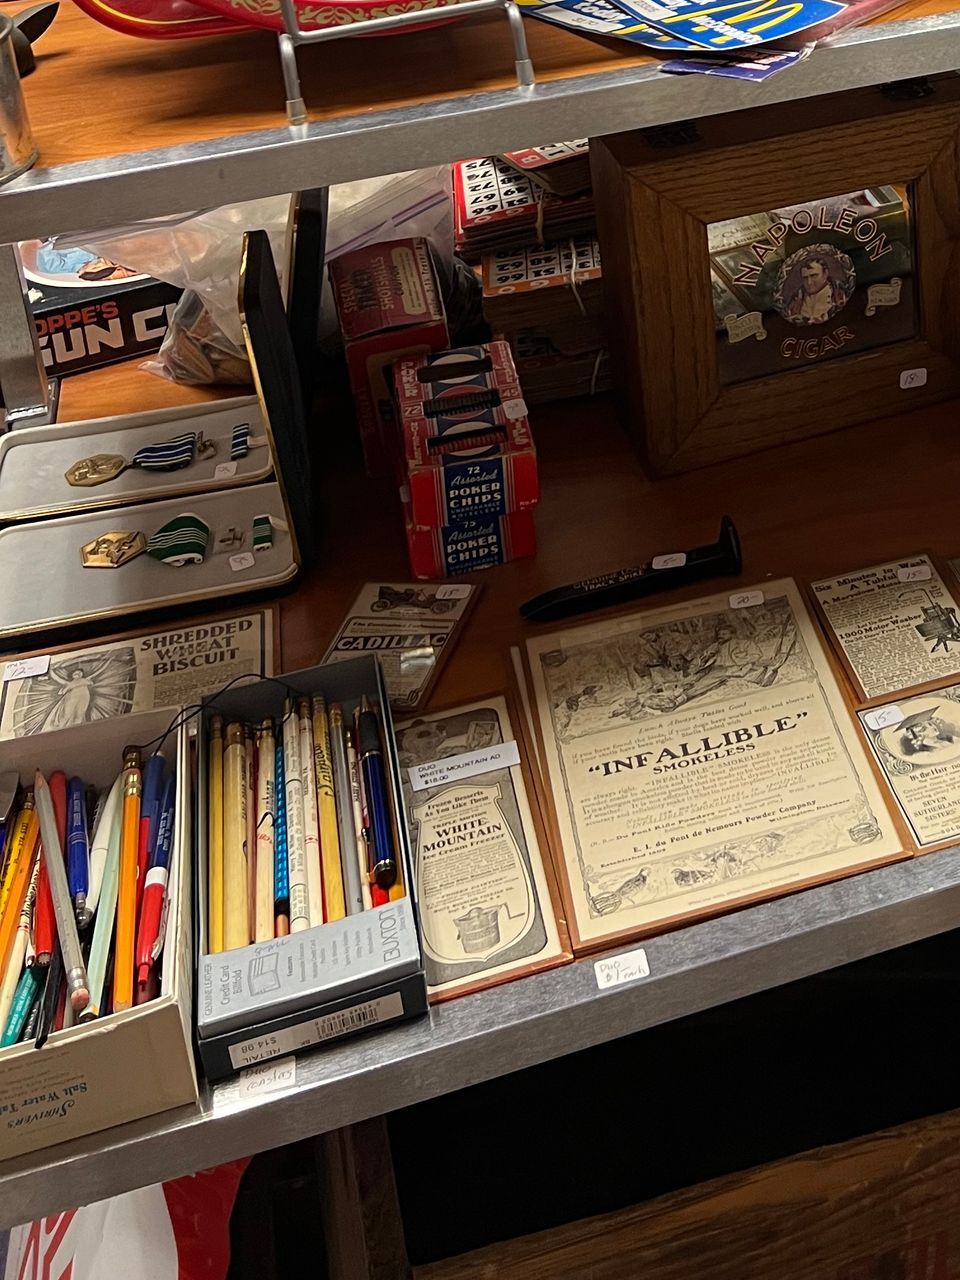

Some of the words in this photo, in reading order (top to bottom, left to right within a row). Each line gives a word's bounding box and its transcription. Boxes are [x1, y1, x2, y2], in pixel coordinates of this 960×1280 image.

[468, 181, 495, 192] 72
[470, 193, 496, 205] 67
[503, 186, 528, 197] 49
[472, 204, 498, 216] 66
[505, 196, 529, 207] 51
[733, 206, 893, 287] NAPOLEON
[496, 261, 524, 272] 62
[497, 273, 525, 284] 66
[532, 267, 556, 278] 51
[34, 301, 119, 336] OPPE'S
[780, 325, 856, 359] CIGAR
[451, 470, 497, 486] Assorted
[450, 482, 501, 498] POKER
[450, 493, 502, 508] CHIPS
[449, 524, 494, 541] Assorted
[447, 535, 497, 553] POKER
[448, 545, 499, 563] CHIPS
[815, 583, 832, 593] Six
[836, 571, 877, 588] Minutes
[140, 619, 253, 652] SHREDDED
[838, 628, 863, 641] 1900
[864, 620, 890, 634] Motor
[890, 612, 922, 626] Washer
[156, 635, 235, 661] WHEAT
[337, 633, 447, 650] CADILLAC
[153, 648, 240, 676] BISCUIT
[419, 770, 445, 779] WHITE
[446, 757, 488, 772] MOUNTAIN
[652, 742, 756, 775] SMOKELESS
[418, 764, 436, 773] DUO
[931, 765, 948, 777] Hair
[436, 806, 450, 816] You
[452, 801, 468, 811] Like
[470, 795, 489, 806] Them
[454, 790, 484, 804] Desserts
[922, 795, 947, 806] SEVEN
[436, 818, 488, 839] WHITE
[670, 832, 690, 845] Pont
[705, 817, 743, 836] Nemours
[745, 809, 777, 826] Powder
[779, 799, 817, 817] Company
[423, 823, 502, 853] MOUNTAIN
[423, 851, 437, 861] Ice
[439, 842, 469, 858] Cream
[470, 833, 505, 848] Freezer
[379, 908, 401, 963] BUXTON
[204, 963, 213, 988] LEATHER
[221, 965, 230, 983] Card
[221, 984, 231, 1006] Credit
[240, 1036, 278, 1055] $14.98
[241, 1048, 282, 1065] RETAIL
[64, 1081, 88, 1097] Salt
[21, 1090, 61, 1108] Water
